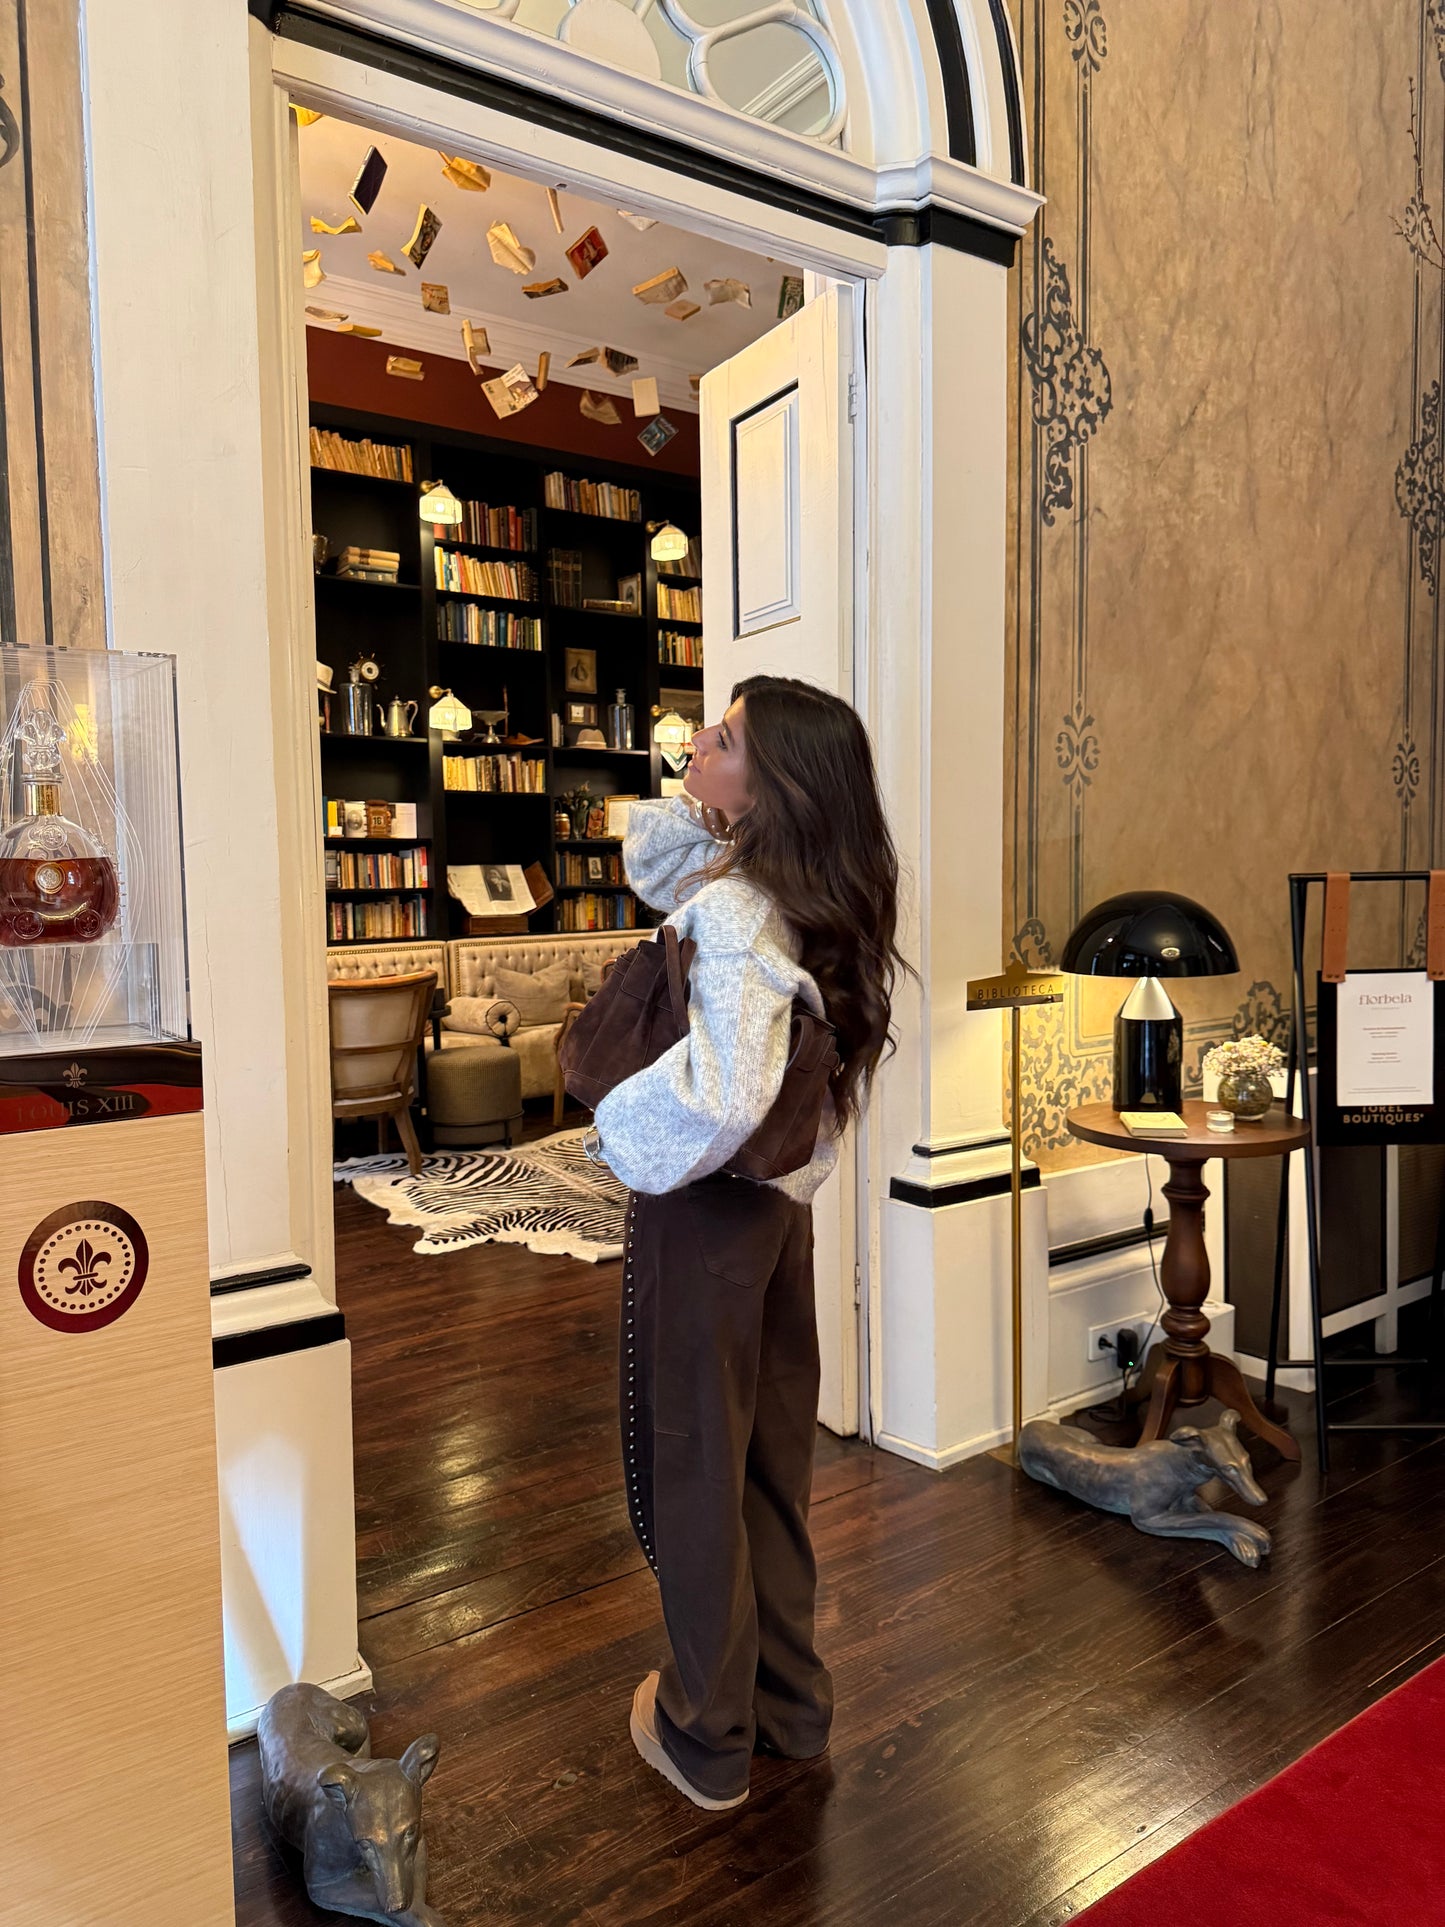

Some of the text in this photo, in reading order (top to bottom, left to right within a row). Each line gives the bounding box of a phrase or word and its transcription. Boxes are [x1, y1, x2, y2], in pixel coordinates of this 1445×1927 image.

[977, 984, 1054, 999] BIBLIOTECA
[18, 1095, 135, 1121] LOUIS XIII
